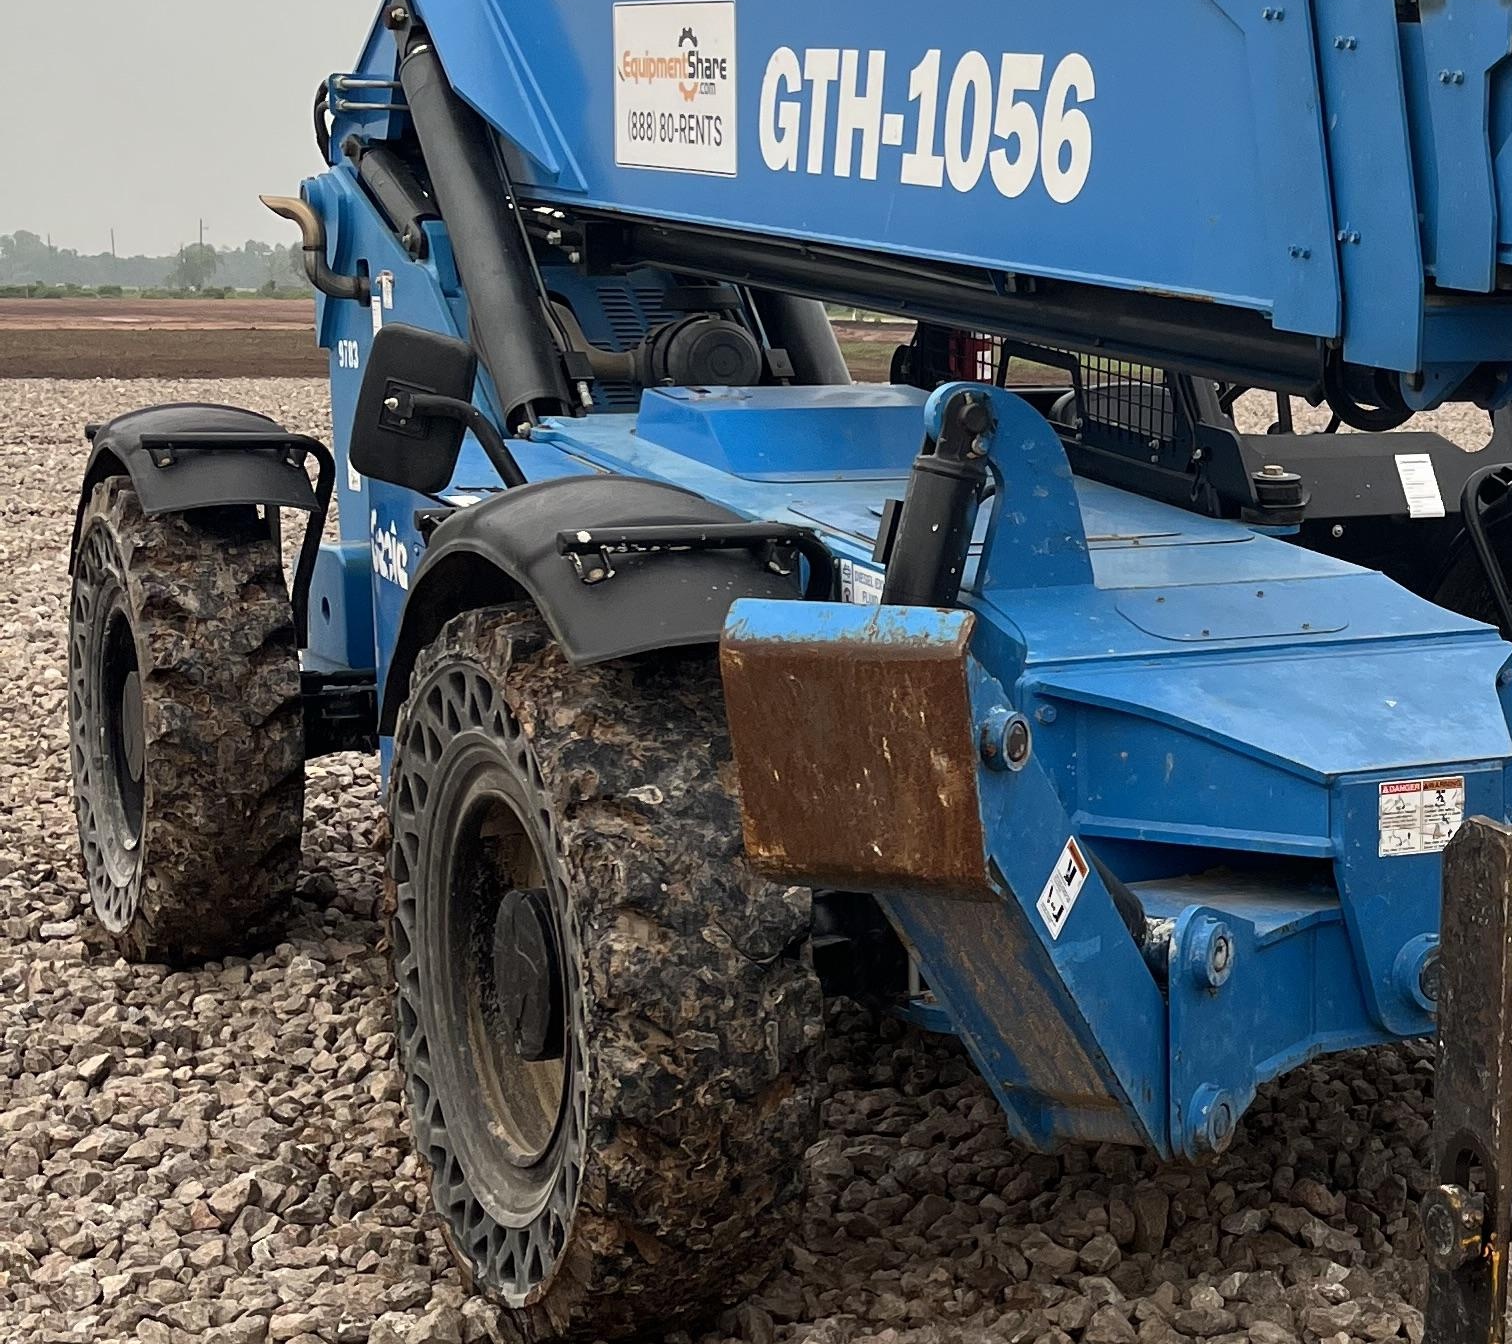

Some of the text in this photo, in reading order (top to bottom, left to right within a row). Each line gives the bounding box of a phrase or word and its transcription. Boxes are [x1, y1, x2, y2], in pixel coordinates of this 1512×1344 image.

[622, 50, 727, 84] EquipmentShare
[699, 82, 716, 95] .com
[628, 109, 723, 147] (888) 80-RENTS
[759, 46, 1096, 205] GTH-1056
